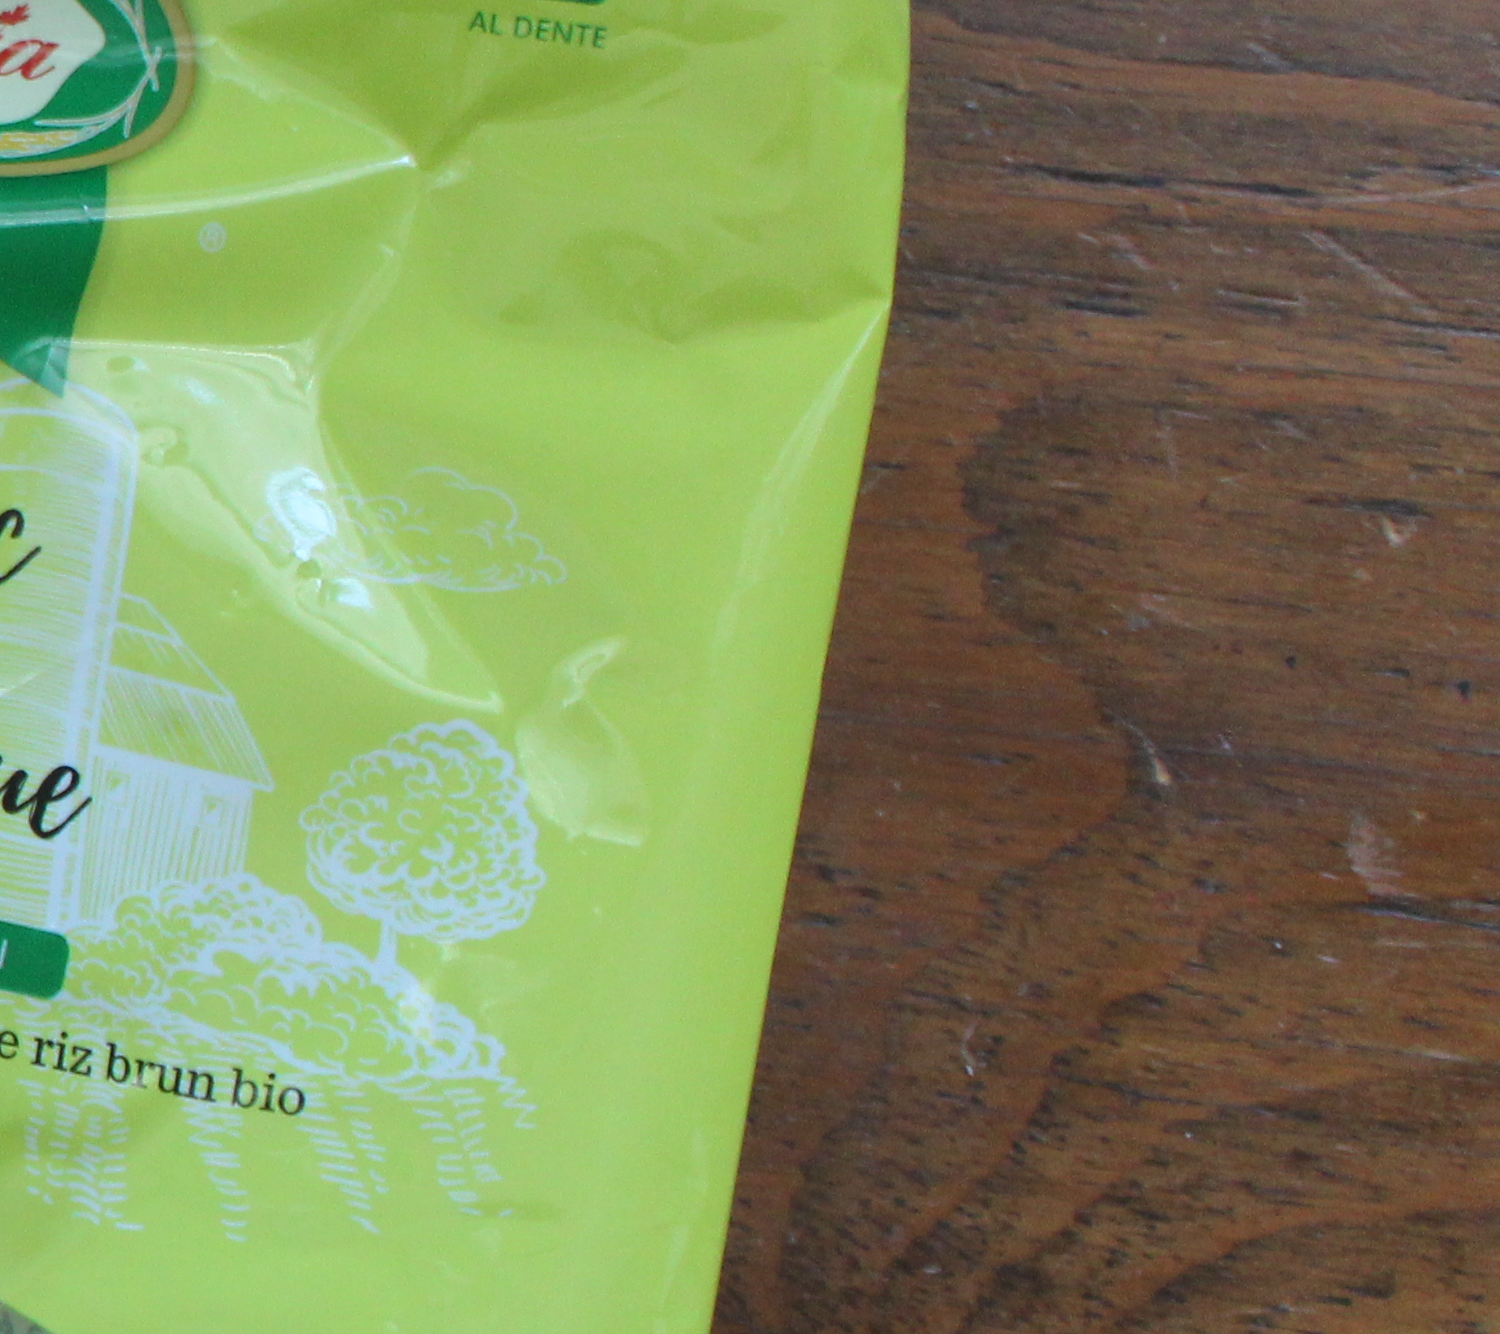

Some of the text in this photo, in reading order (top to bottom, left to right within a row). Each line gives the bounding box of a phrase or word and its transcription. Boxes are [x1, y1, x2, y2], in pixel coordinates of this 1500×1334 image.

[468, 10, 608, 50] AL DENTE
[30, 1030, 94, 1078] riz
[105, 1043, 218, 1104] brun
[230, 1066, 307, 1117] bio
